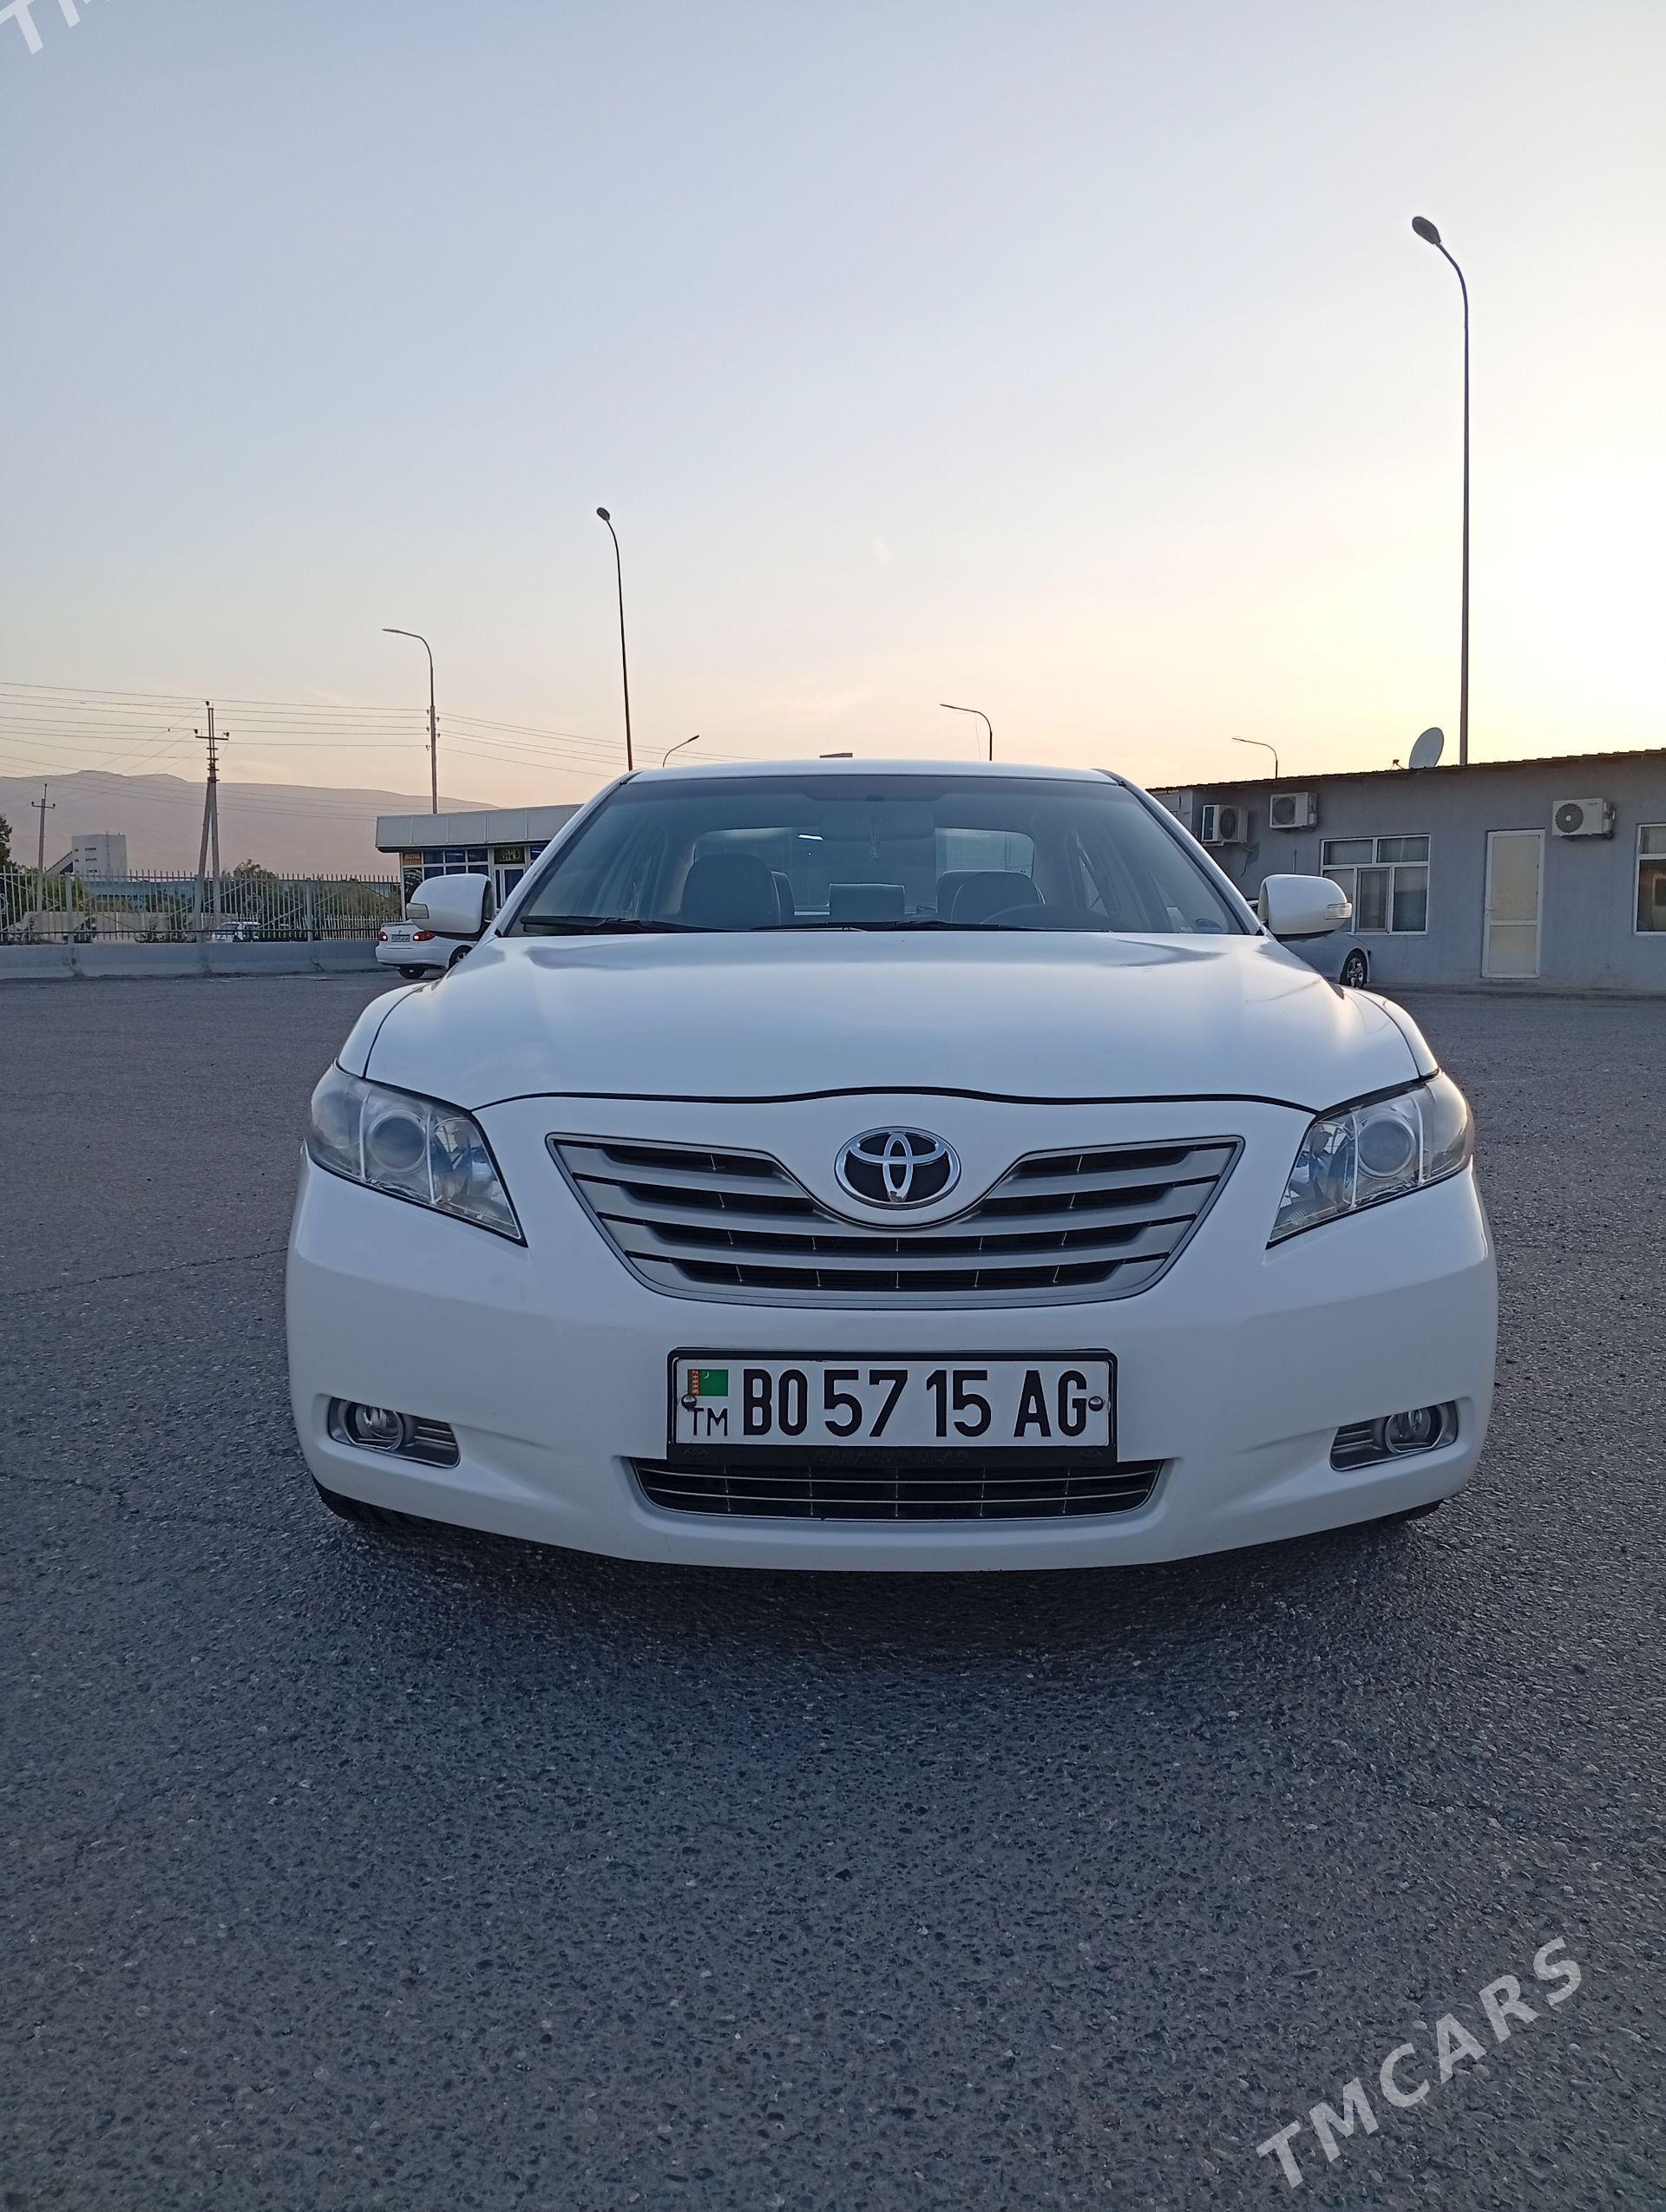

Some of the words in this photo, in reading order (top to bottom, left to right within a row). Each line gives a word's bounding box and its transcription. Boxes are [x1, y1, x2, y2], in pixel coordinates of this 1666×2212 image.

[687, 1408, 728, 1436] TM
[824, 1370, 908, 1436] 57
[926, 1370, 992, 1436] 15
[1013, 1370, 1086, 1436] AG
